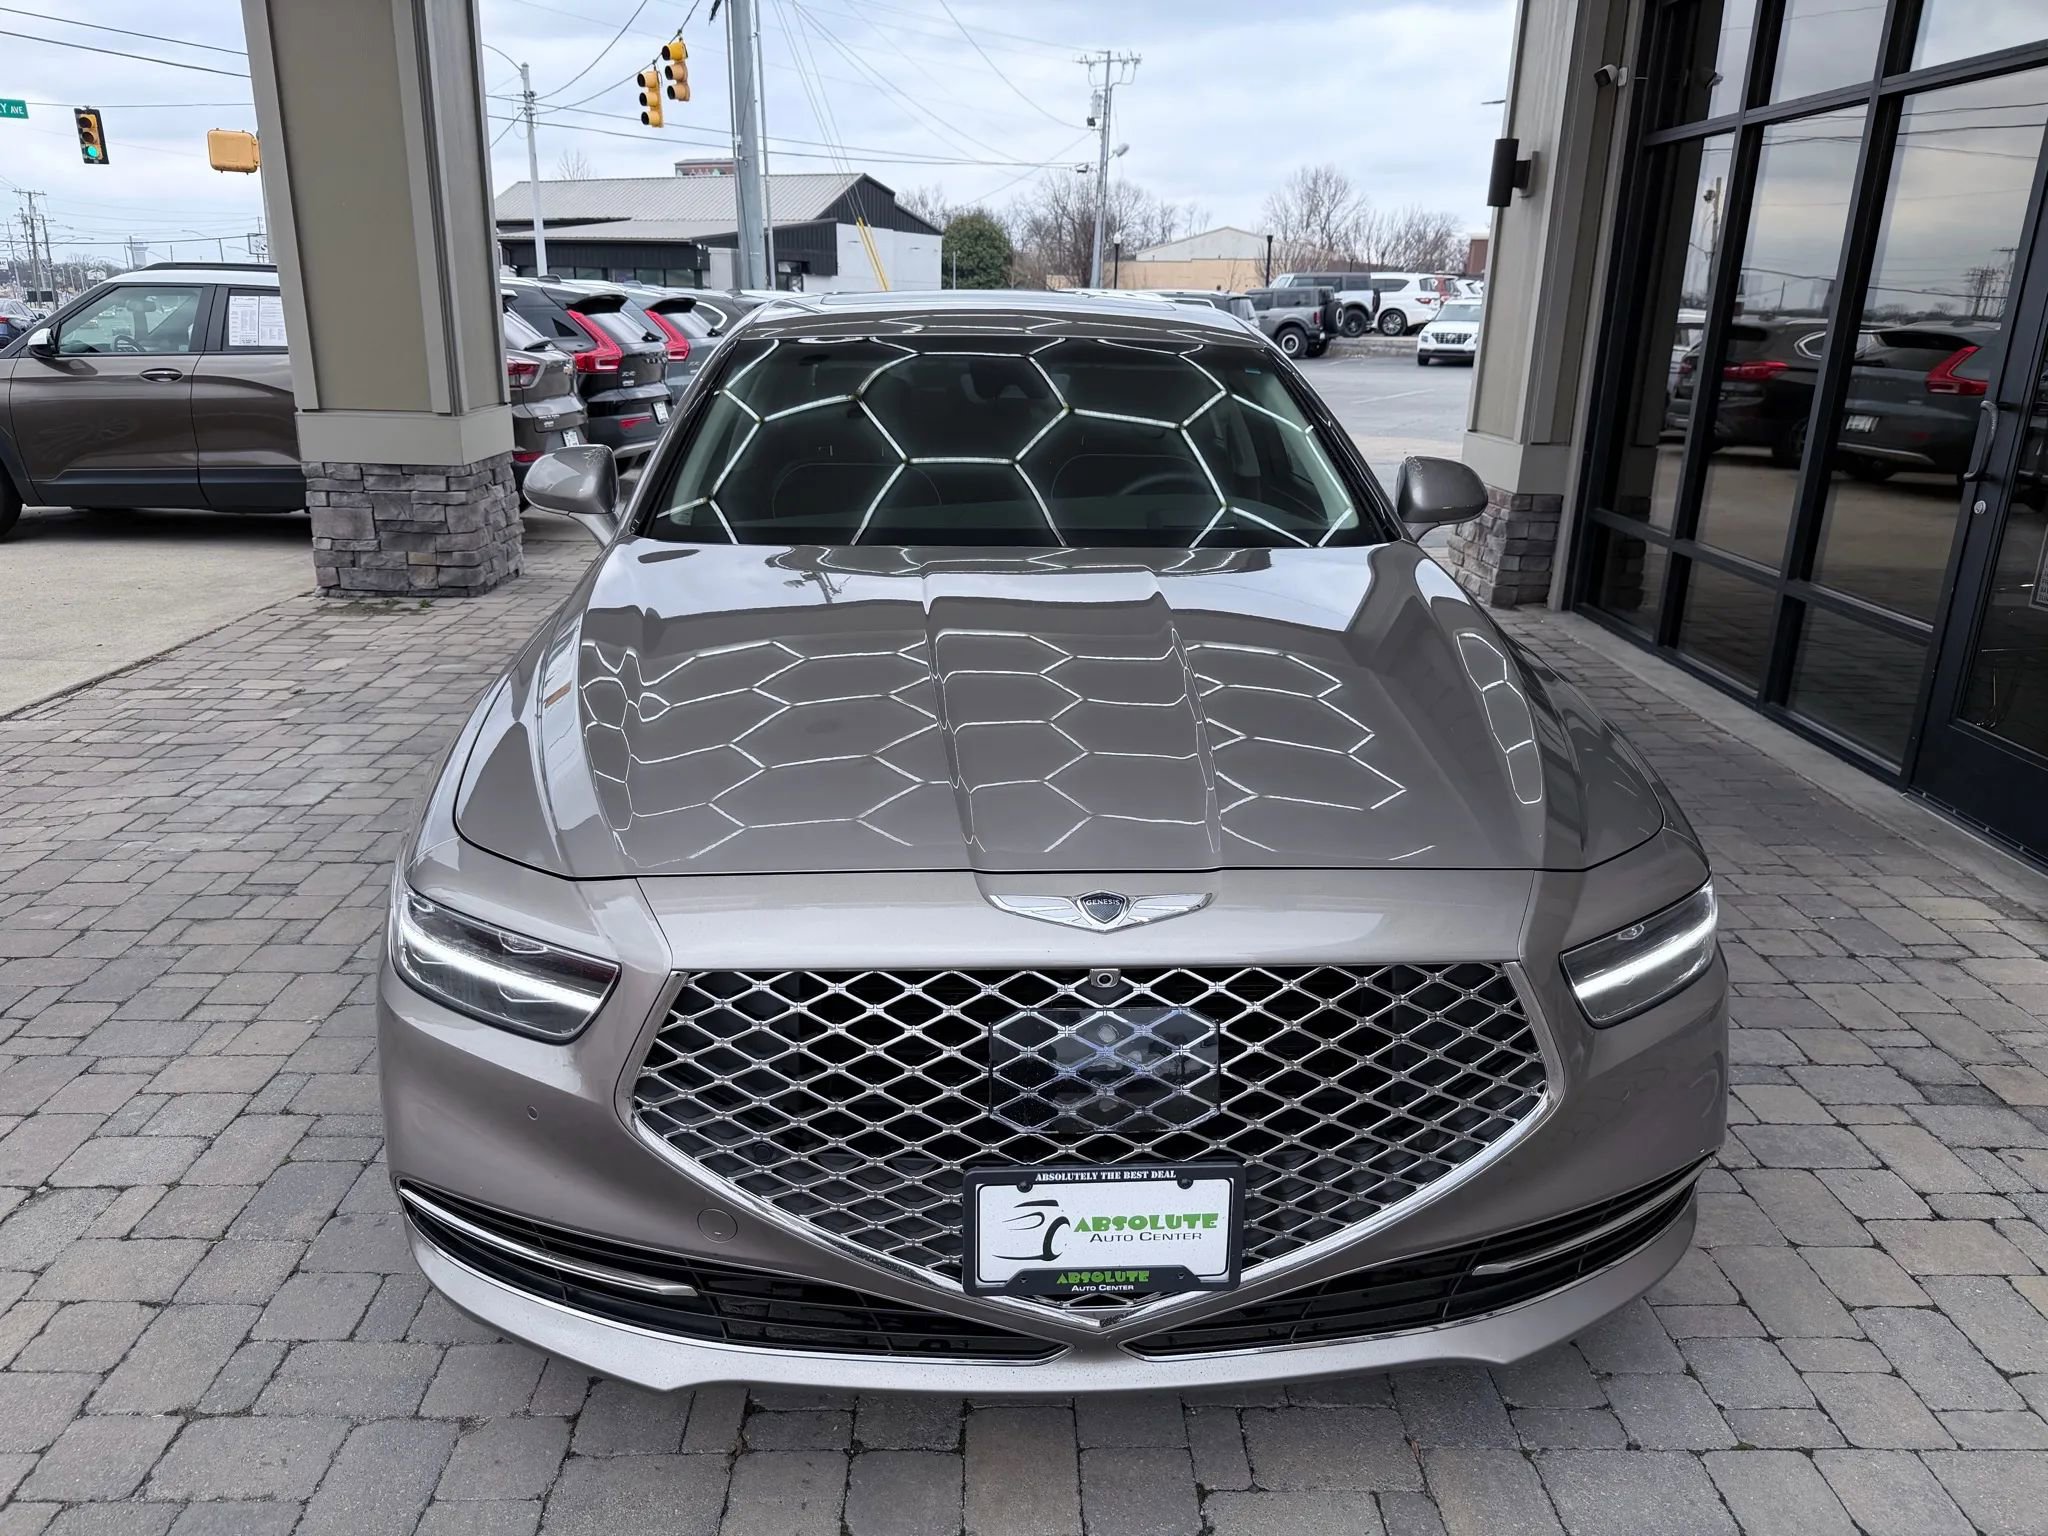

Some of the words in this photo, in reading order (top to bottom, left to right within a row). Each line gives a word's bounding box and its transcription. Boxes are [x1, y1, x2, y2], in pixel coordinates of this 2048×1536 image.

[0, 102, 7, 114] Y
[10, 105, 25, 115] AVE
[1085, 898, 1121, 906] GENESIS
[1035, 1172, 1099, 1182] ABSOLUTELY
[1101, 1171, 1121, 1180] THE
[1123, 1171, 1149, 1180] BEST
[1151, 1170, 1177, 1179] DEAL
[1073, 1213, 1219, 1233] ABSOLUTE
[1089, 1233, 1134, 1243] AUTO
[1139, 1231, 1203, 1242] CENTER
[1056, 1270, 1150, 1284] ABSOLUTE
[1071, 1284, 1097, 1292] AUTO
[1098, 1284, 1135, 1292] CENTER
